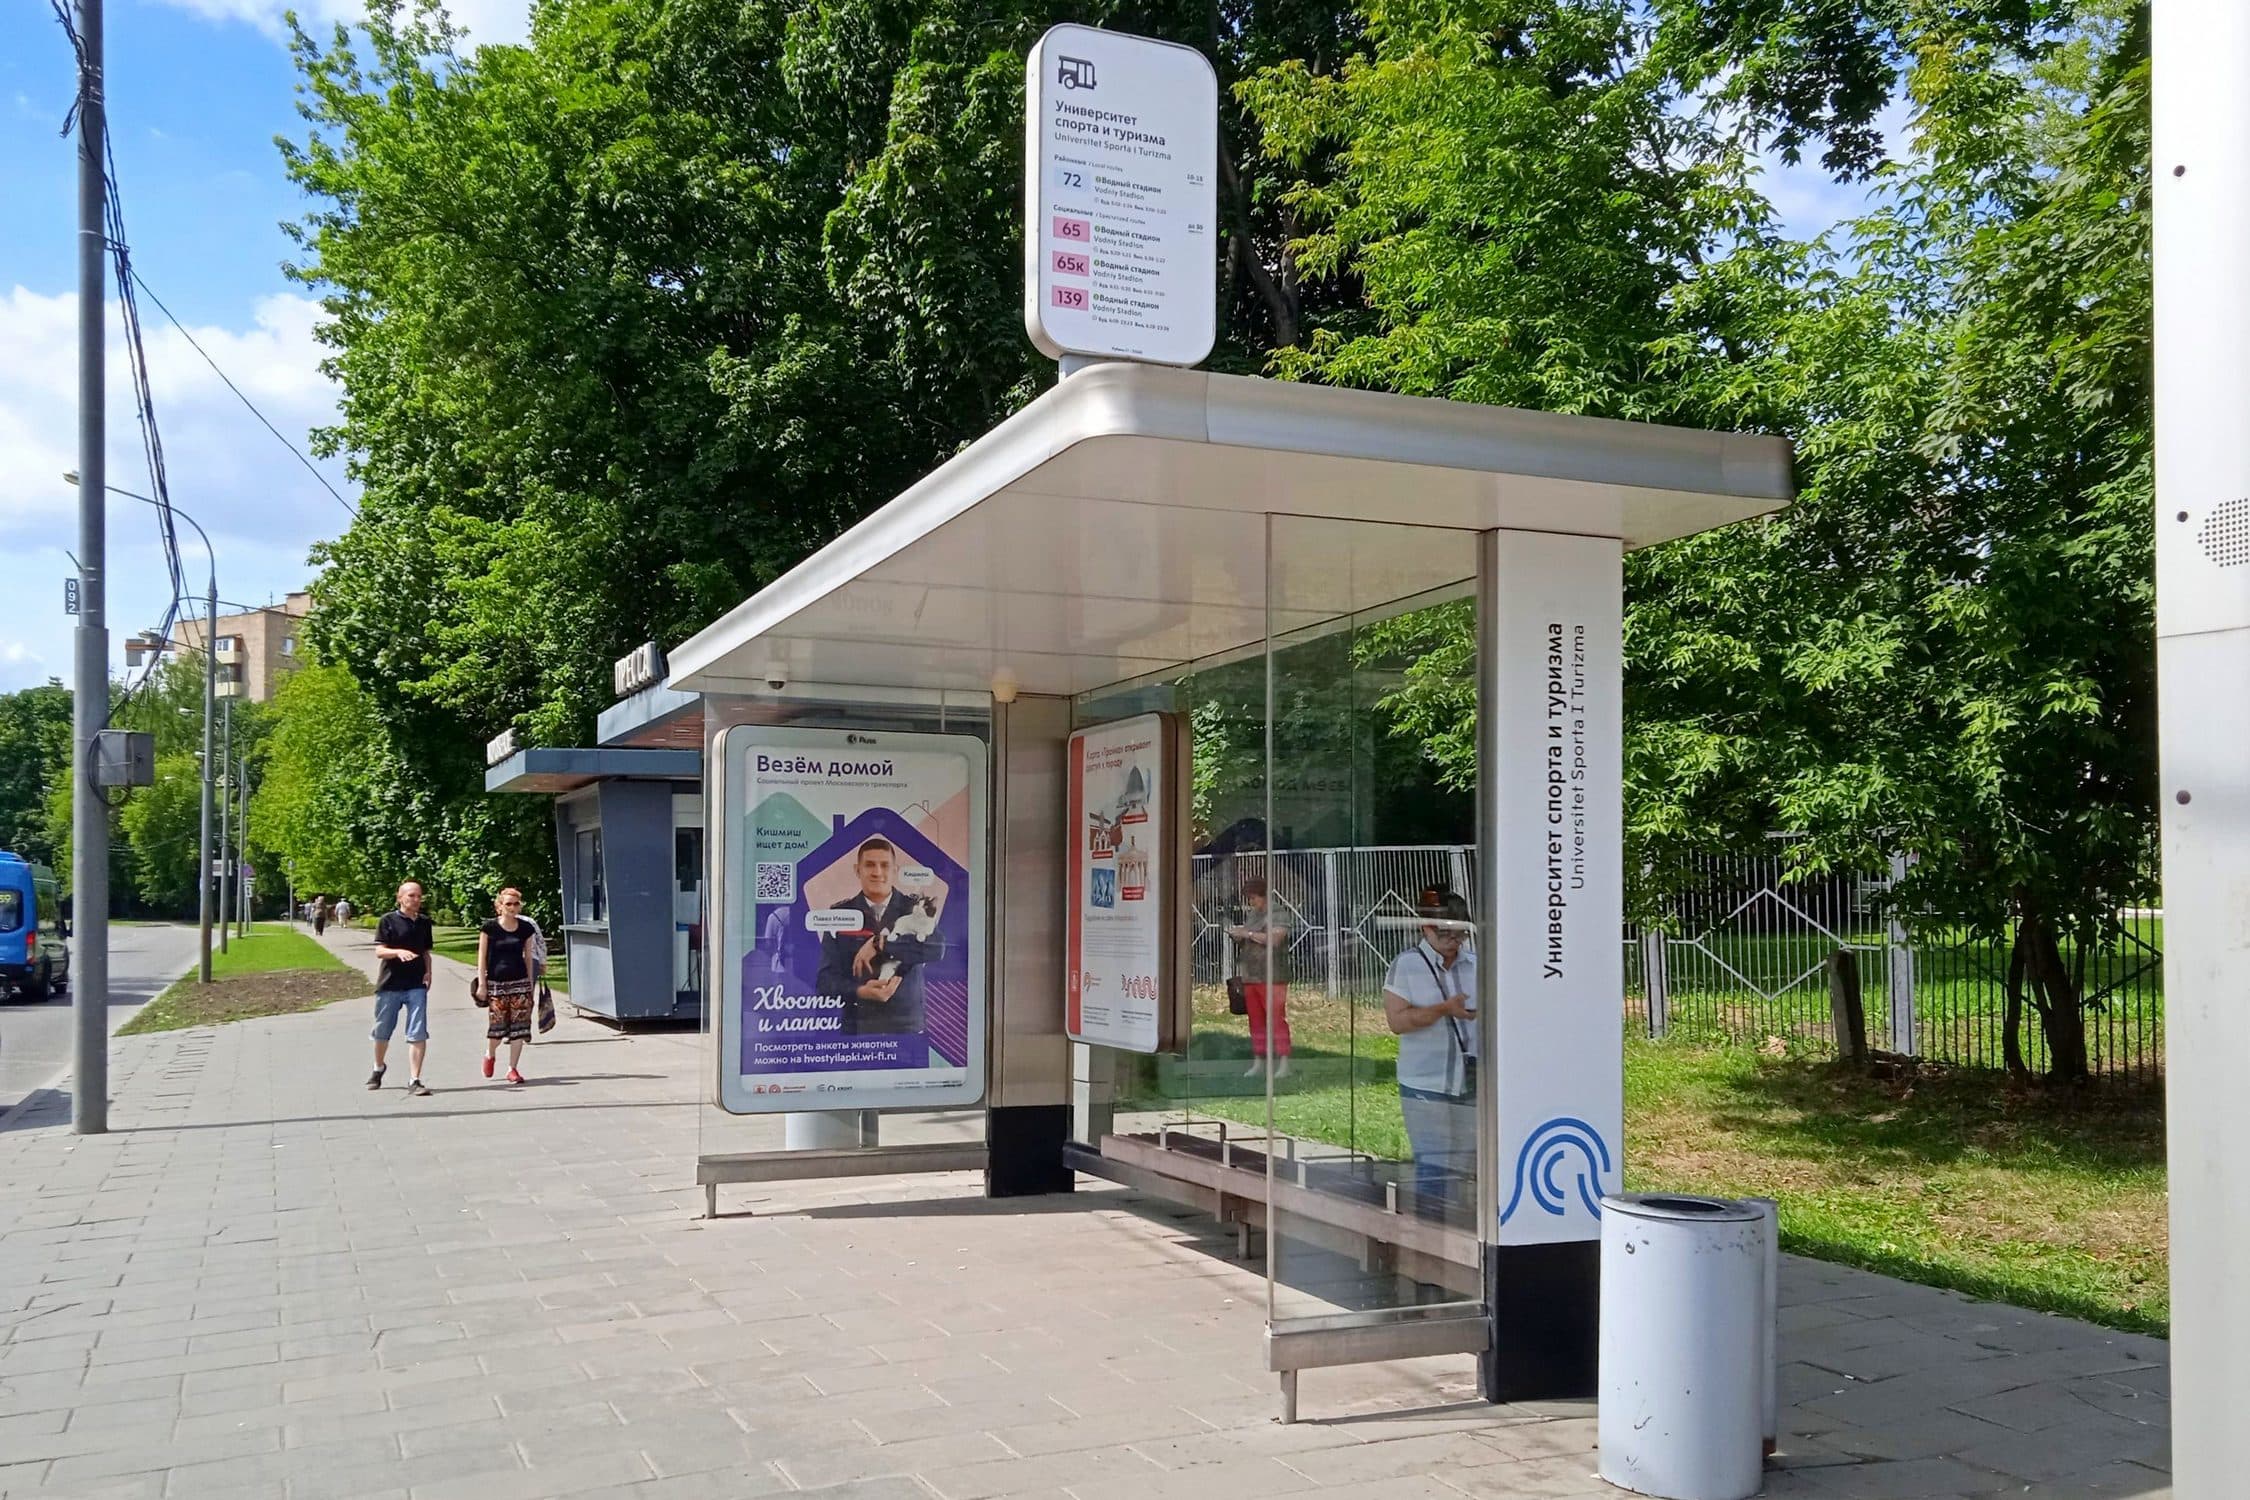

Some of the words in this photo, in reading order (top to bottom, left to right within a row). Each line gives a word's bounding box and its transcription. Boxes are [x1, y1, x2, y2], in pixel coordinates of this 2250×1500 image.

[1056, 100, 1137, 126] Университет
[1056, 116, 1098, 134] спорта
[1103, 126, 1110, 136] и
[1113, 127, 1166, 146] туризма
[1055, 132, 1102, 148] Universitet
[1104, 139, 1132, 154] Sporta
[1138, 147, 1171, 160] Turizma
[1064, 172, 1082, 188] 72
[1102, 176, 1130, 190] Водный
[1132, 182, 1161, 194] стадион
[1120, 190, 1144, 200] Stadion
[1062, 222, 1080, 237] 65
[1102, 226, 1130, 239] Водный
[1132, 232, 1160, 242] стадион
[1118, 240, 1144, 250] Stadion
[1100, 260, 1129, 273] Водный
[1131, 265, 1160, 276] стадион
[1118, 274, 1143, 284] Stadion
[1058, 290, 1082, 306] 139
[1100, 294, 1128, 307] Водный
[1130, 299, 1160, 310] стадион
[1117, 308, 1142, 318] Stadion
[1571, 624, 1584, 699] Turizma
[1549, 623, 1567, 718] туризма
[1550, 726, 1562, 738] и
[1571, 723, 1587, 780] Sporta
[757, 755, 822, 774] Везём
[828, 760, 893, 776] домой
[1549, 746, 1567, 824] спорта
[756, 828, 800, 836] Кишмиш
[1571, 786, 1584, 890] Universitet
[756, 841, 782, 850] ищет
[784, 840, 808, 850] дом!
[1544, 829, 1567, 979] Университет
[752, 985, 846, 1012] Хвосты
[758, 1018, 772, 1032] и
[776, 1016, 842, 1032] лапки
[755, 1042, 812, 1054] Посмотреть
[816, 1042, 849, 1050] анкеты
[851, 1040, 898, 1050] животных
[754, 1056, 788, 1064] можно
